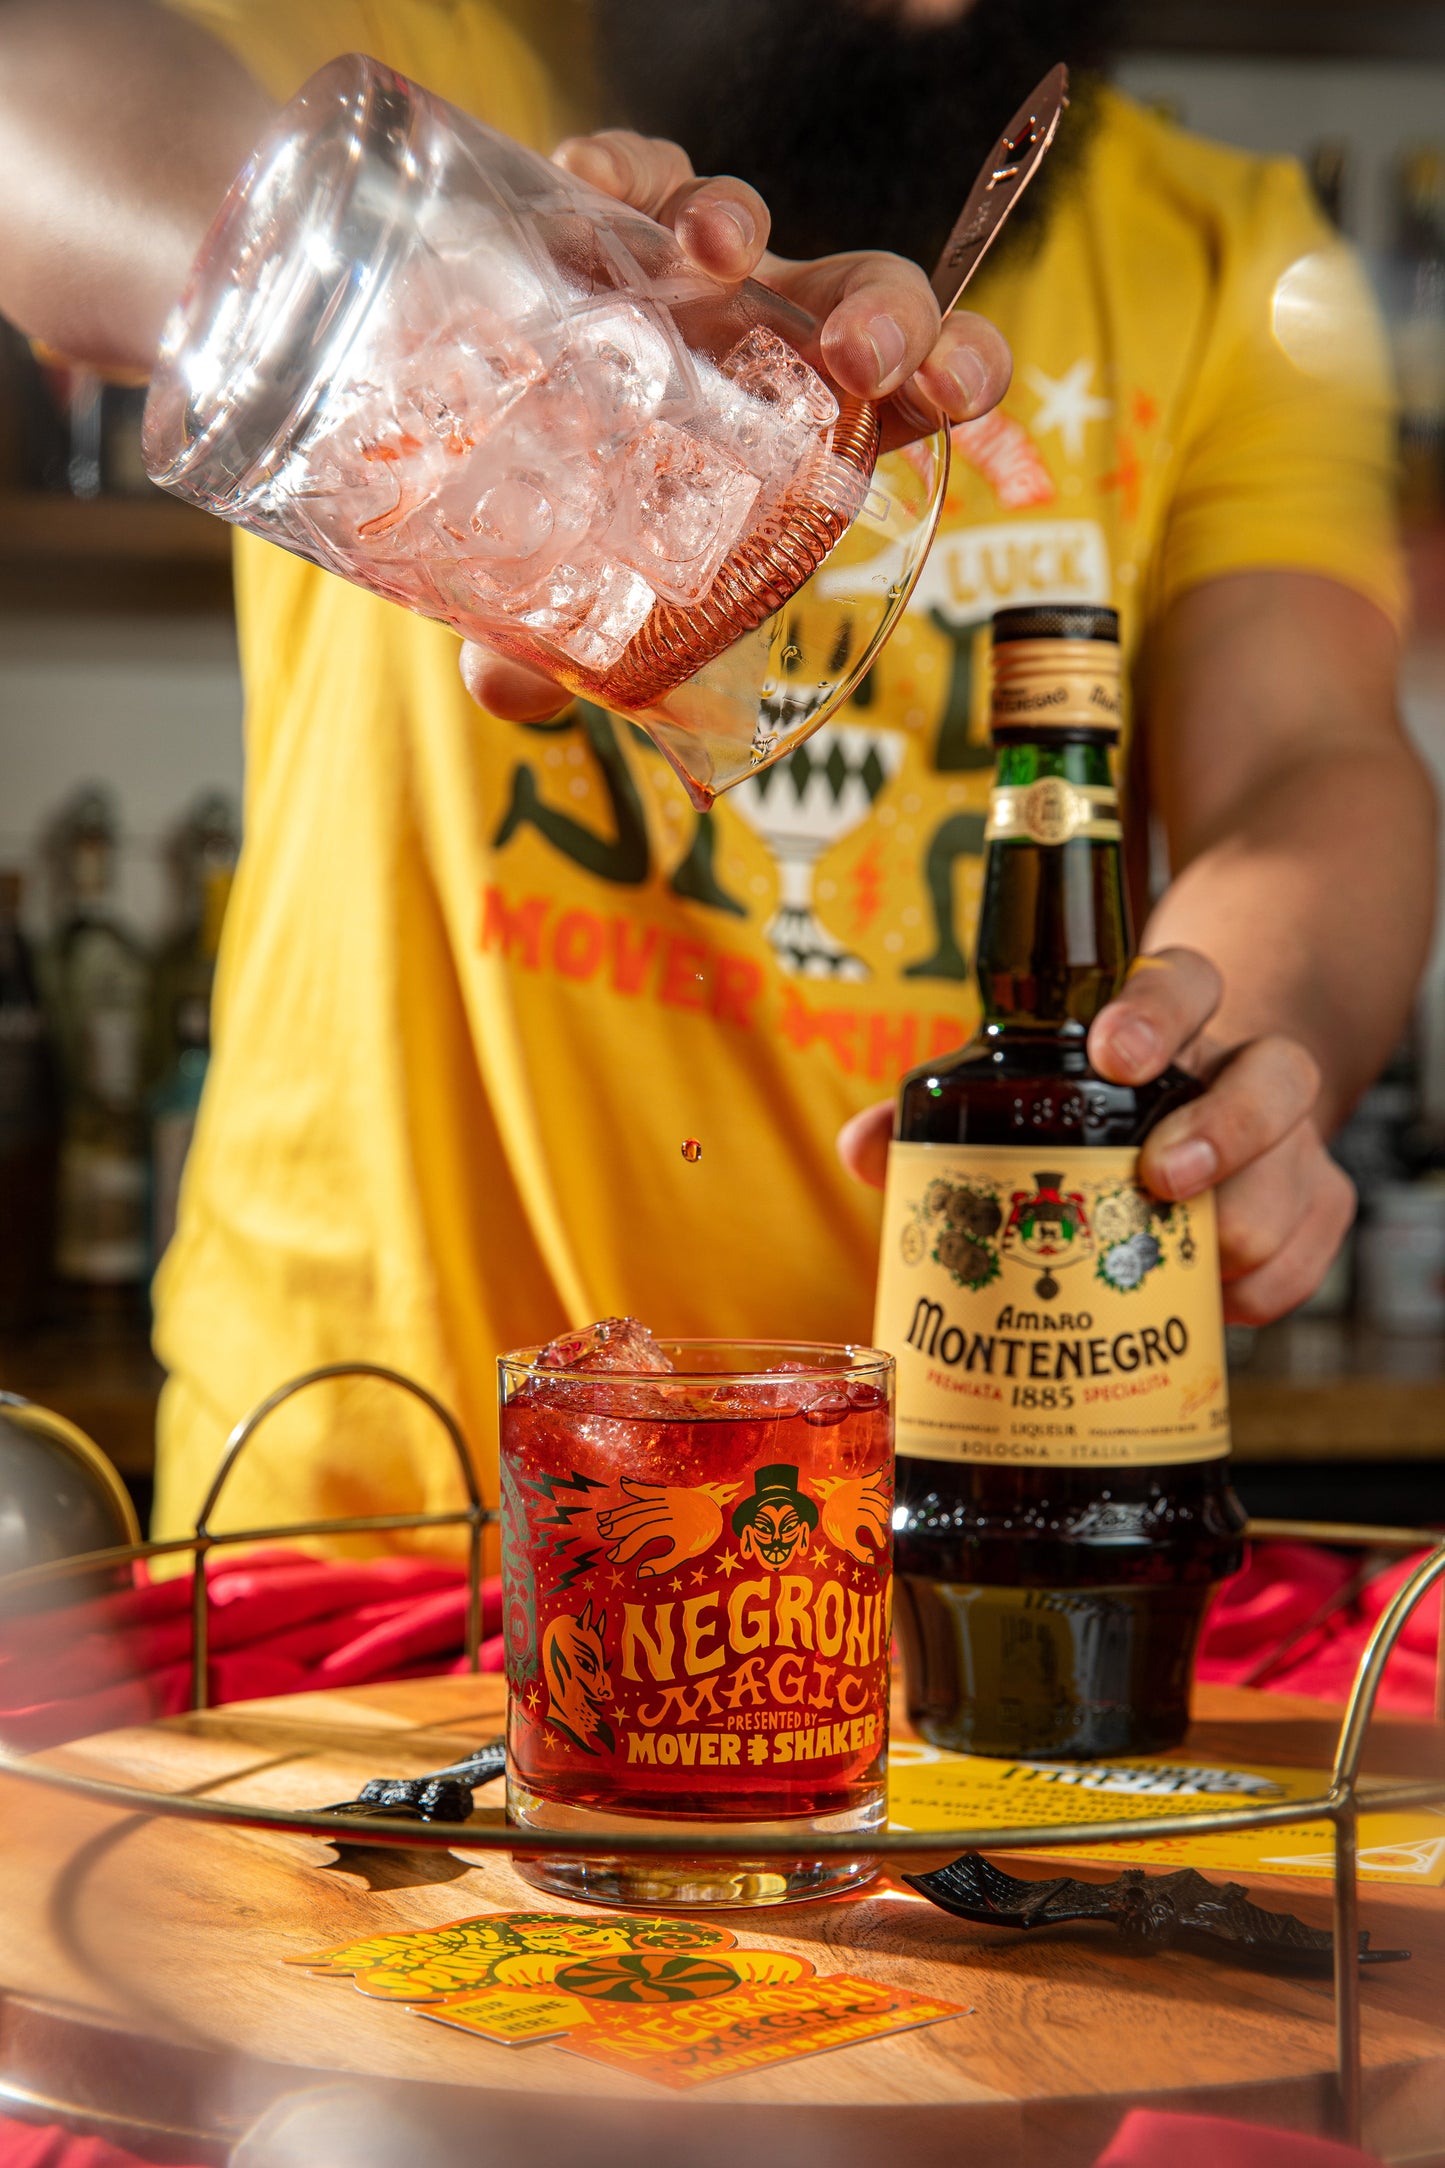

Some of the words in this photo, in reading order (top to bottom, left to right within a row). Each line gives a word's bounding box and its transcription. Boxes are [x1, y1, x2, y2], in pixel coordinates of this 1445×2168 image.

[478, 883, 764, 1030] MOVER
[906, 1297, 1189, 1380] MONTENEGRO
[926, 1368, 1003, 1402] PREMIATA
[1011, 1385, 1075, 1409] 1885
[961, 1440, 1049, 1458] BOLOGNA
[1071, 1444, 1129, 1458] ITALIA
[1010, 1422, 1077, 1437] LIQUEUR
[621, 1575, 882, 1682] NEGRONI
[637, 1653, 869, 1727] MAGIC
[627, 1732, 741, 1766] MOVER
[773, 1713, 877, 1764] SHAKER
[727, 1711, 801, 1731] PRESENTED
[804, 1712, 819, 1727] BY
[331, 1929, 500, 1968] SUMMON
[367, 1943, 522, 1995] SPIRITS
[382, 1942, 452, 1968] THE
[454, 2000, 512, 2016] YOUR
[476, 1999, 570, 2024] FORTUNE
[500, 2016, 559, 2034] HERE
[588, 1978, 892, 2060] NEGRONI
[671, 2001, 899, 2065] MAGIC
[677, 2044, 797, 2080] MOVER
[810, 2005, 949, 2044] SHAKER
